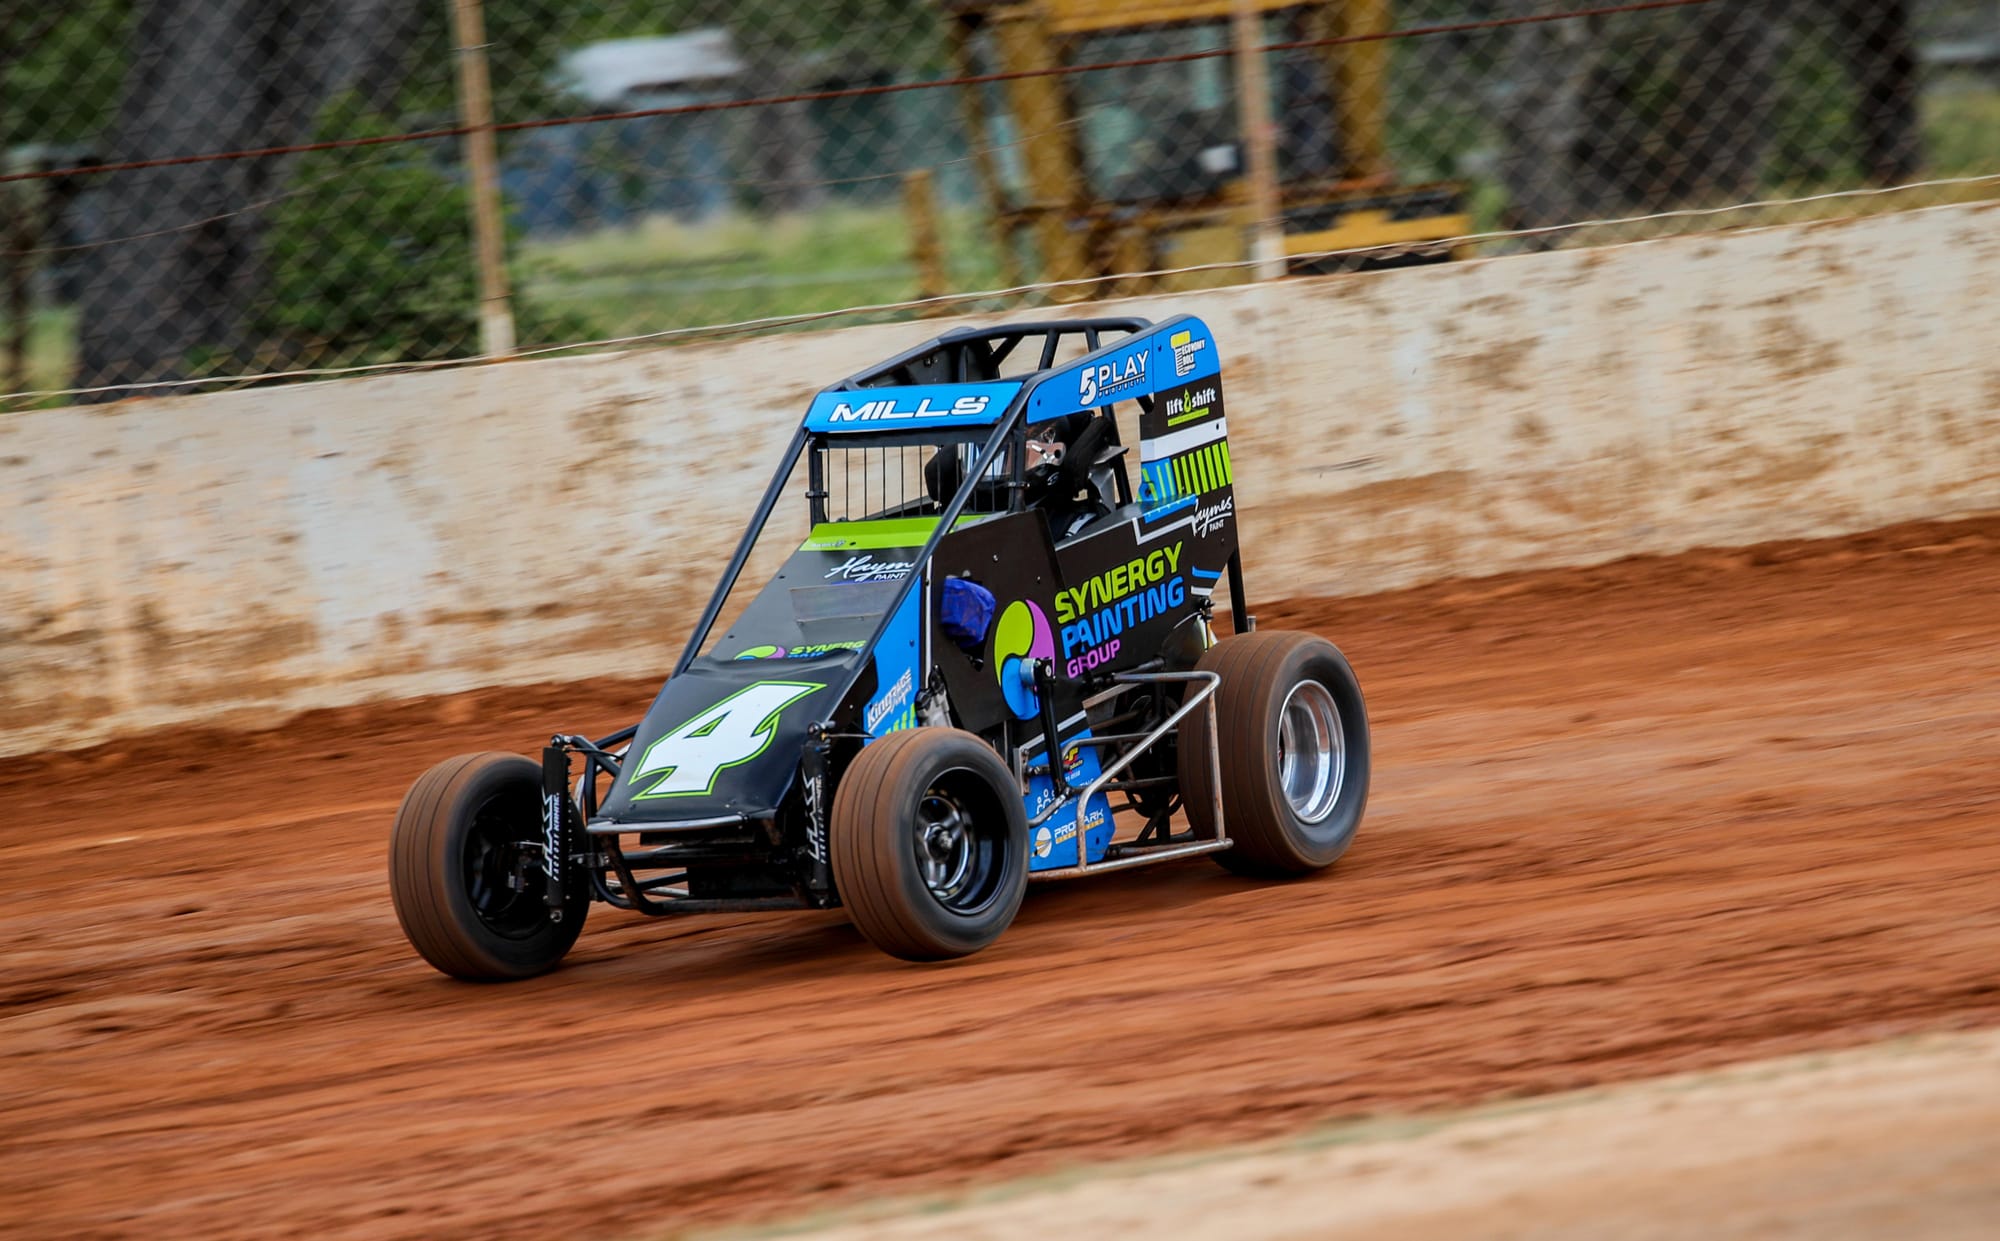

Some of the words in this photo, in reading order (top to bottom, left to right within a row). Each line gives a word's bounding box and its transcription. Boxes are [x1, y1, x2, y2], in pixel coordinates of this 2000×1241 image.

[829, 396, 990, 422] MILLS
[1209, 519, 1225, 532] PAINT
[873, 572, 906, 581] PAINT
[1054, 541, 1183, 624] SYNERGY
[1060, 576, 1185, 660] PAINTING
[789, 640, 867, 656] SYNERG
[1067, 638, 1121, 679] GROUP
[629, 681, 828, 801] 4
[1054, 808, 1104, 839] PROARK
